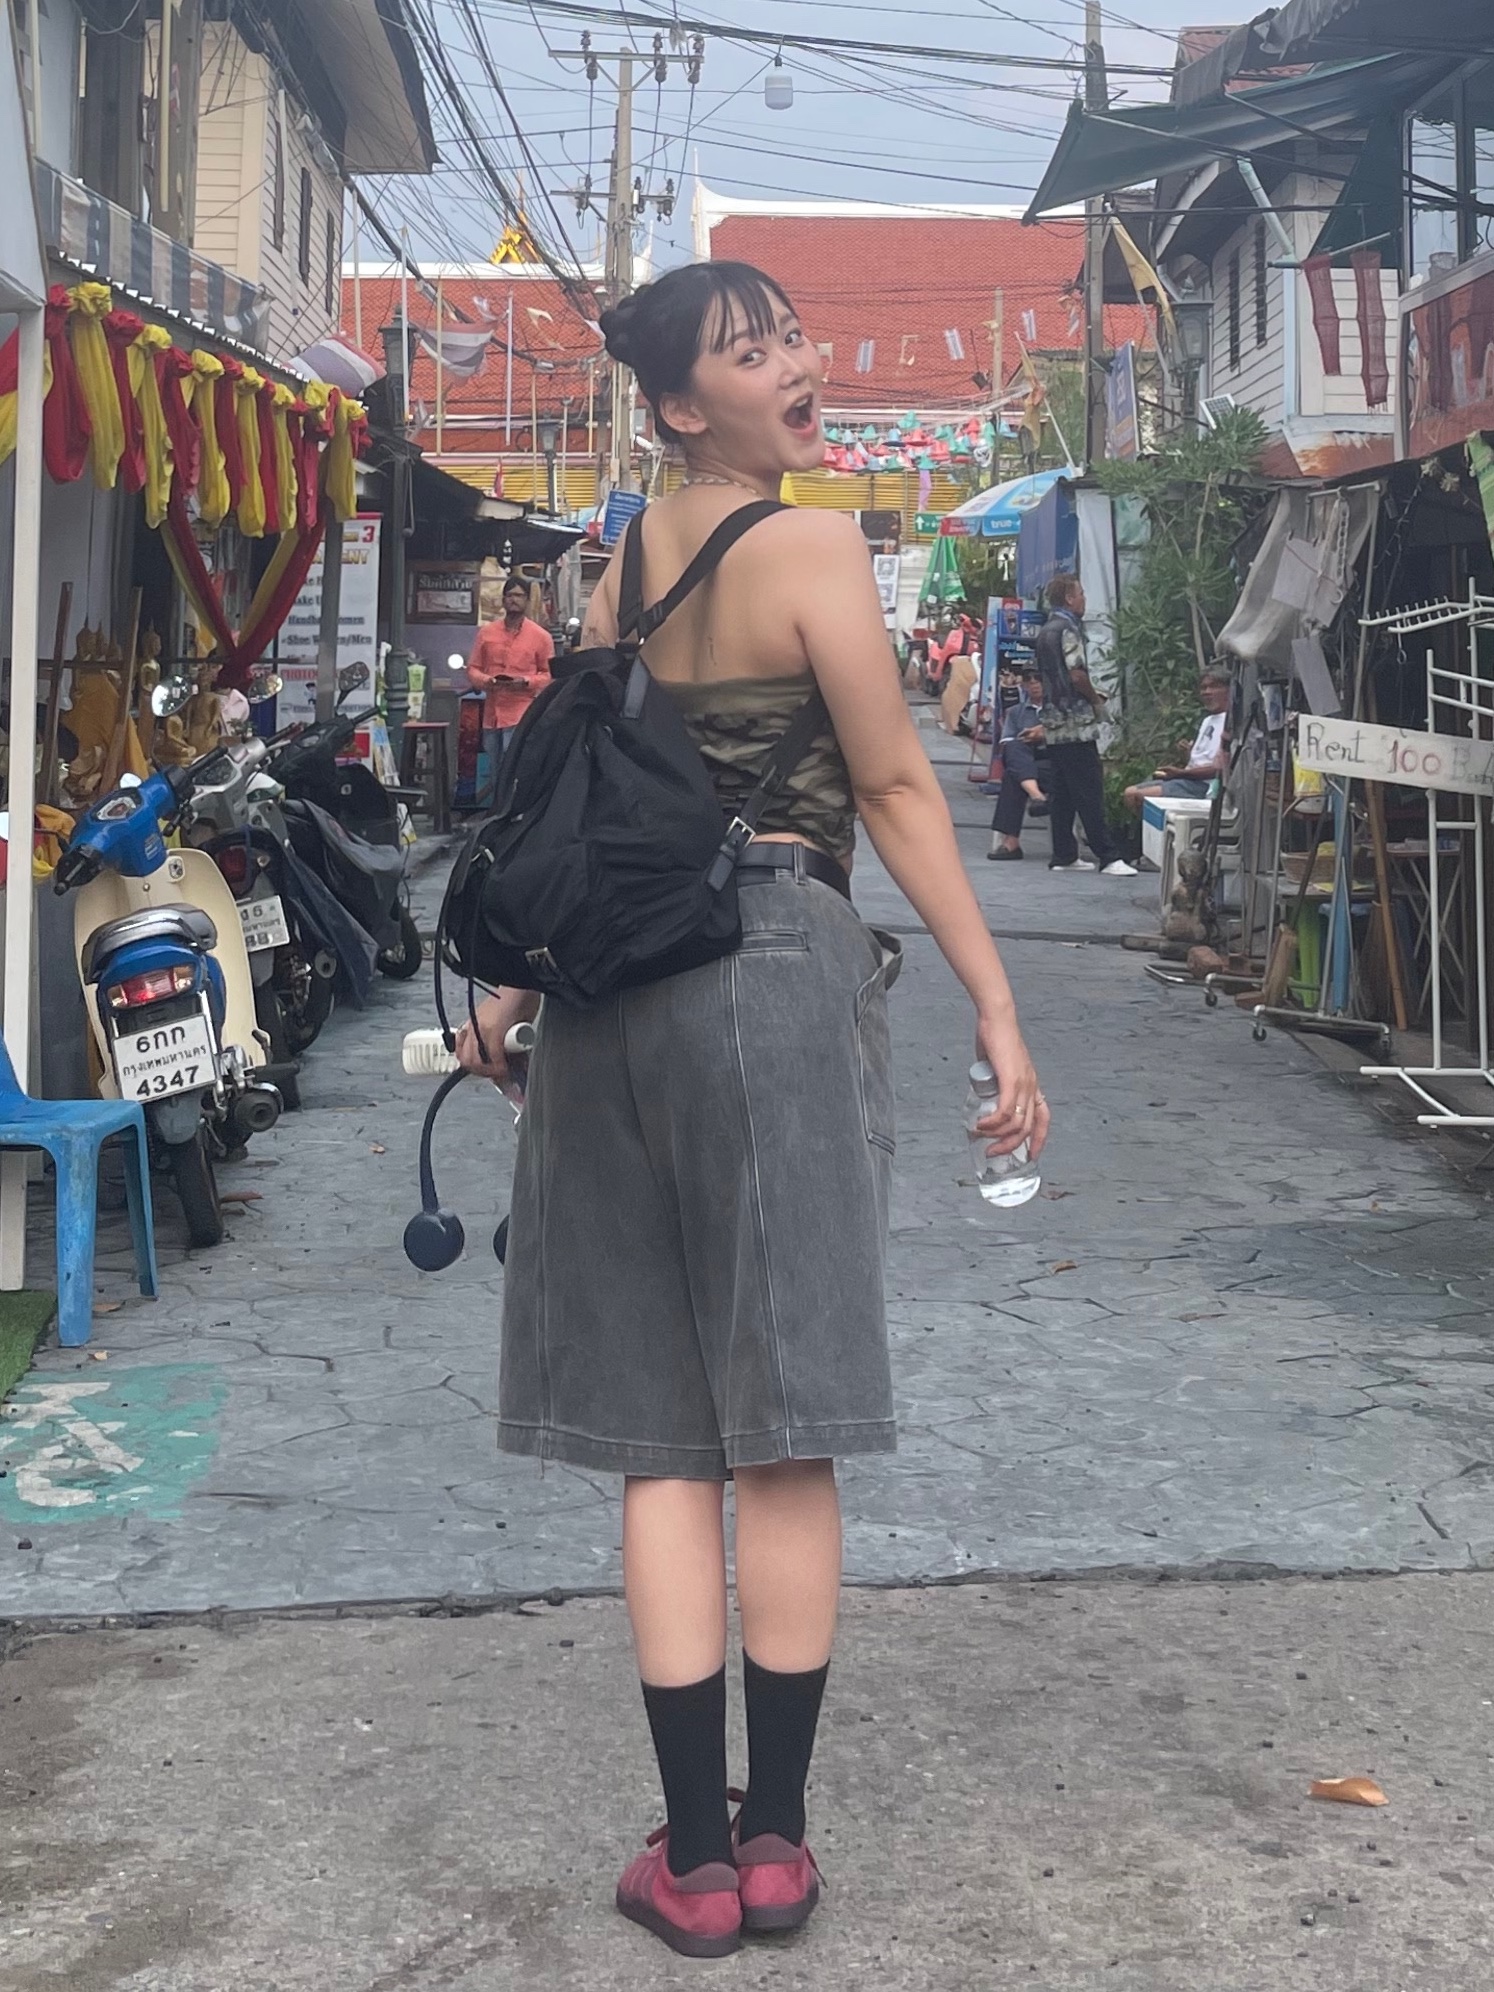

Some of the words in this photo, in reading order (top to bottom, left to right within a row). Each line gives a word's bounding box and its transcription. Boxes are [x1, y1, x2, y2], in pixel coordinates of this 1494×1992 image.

[362, 526, 375, 542] 3
[1306, 722, 1365, 763] Rent
[1387, 740, 1442, 776] 100
[136, 1026, 186, 1053] 6กก
[123, 1045, 207, 1078] กรุงเทพมหานคร
[136, 1065, 200, 1097] 4347
